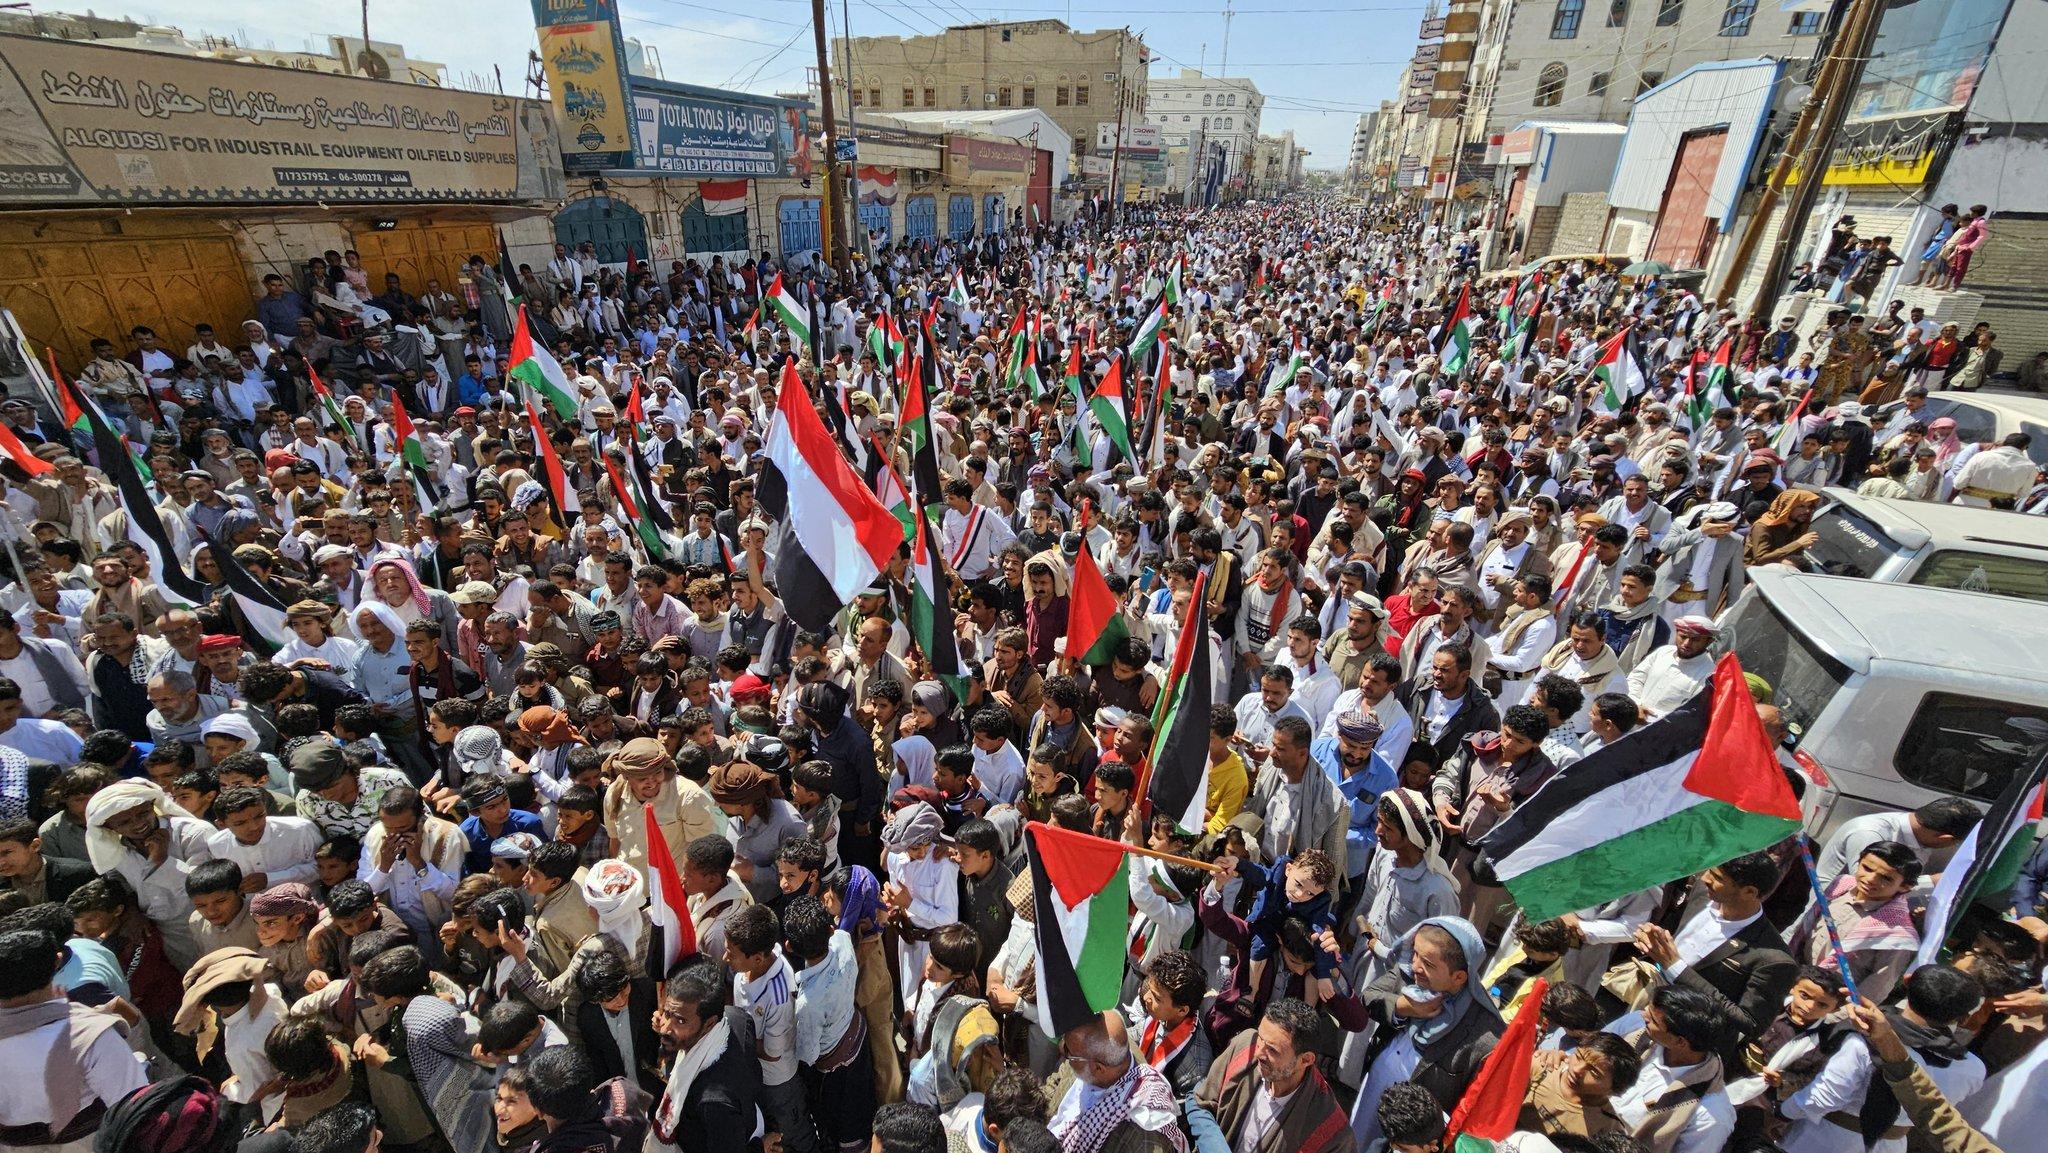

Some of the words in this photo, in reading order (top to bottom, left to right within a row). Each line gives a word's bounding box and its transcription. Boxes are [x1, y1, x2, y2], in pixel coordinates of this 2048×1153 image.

[41, 69, 129, 109] النفط
[135, 79, 206, 119] حقول
[209, 86, 316, 130] ومستلزمات
[316, 97, 399, 131] الصناعية
[401, 105, 460, 135] للمعدات
[660, 104, 694, 129] TOTAL
[693, 107, 724, 131] TOOLS
[726, 109, 747, 136] تولز
[463, 114, 511, 144] القدسي
[749, 113, 775, 137] توتال
[64, 127, 167, 151] ALQUDSI
[167, 136, 211, 154] FOR
[216, 137, 320, 158] INDUSTRAIL
[320, 143, 403, 161] EQUIPMENT
[407, 147, 462, 164] OILFIELD
[464, 151, 518, 166] SUPPLIES
[277, 171, 330, 183] 717357952
[338, 172, 383, 183] 06-300278
